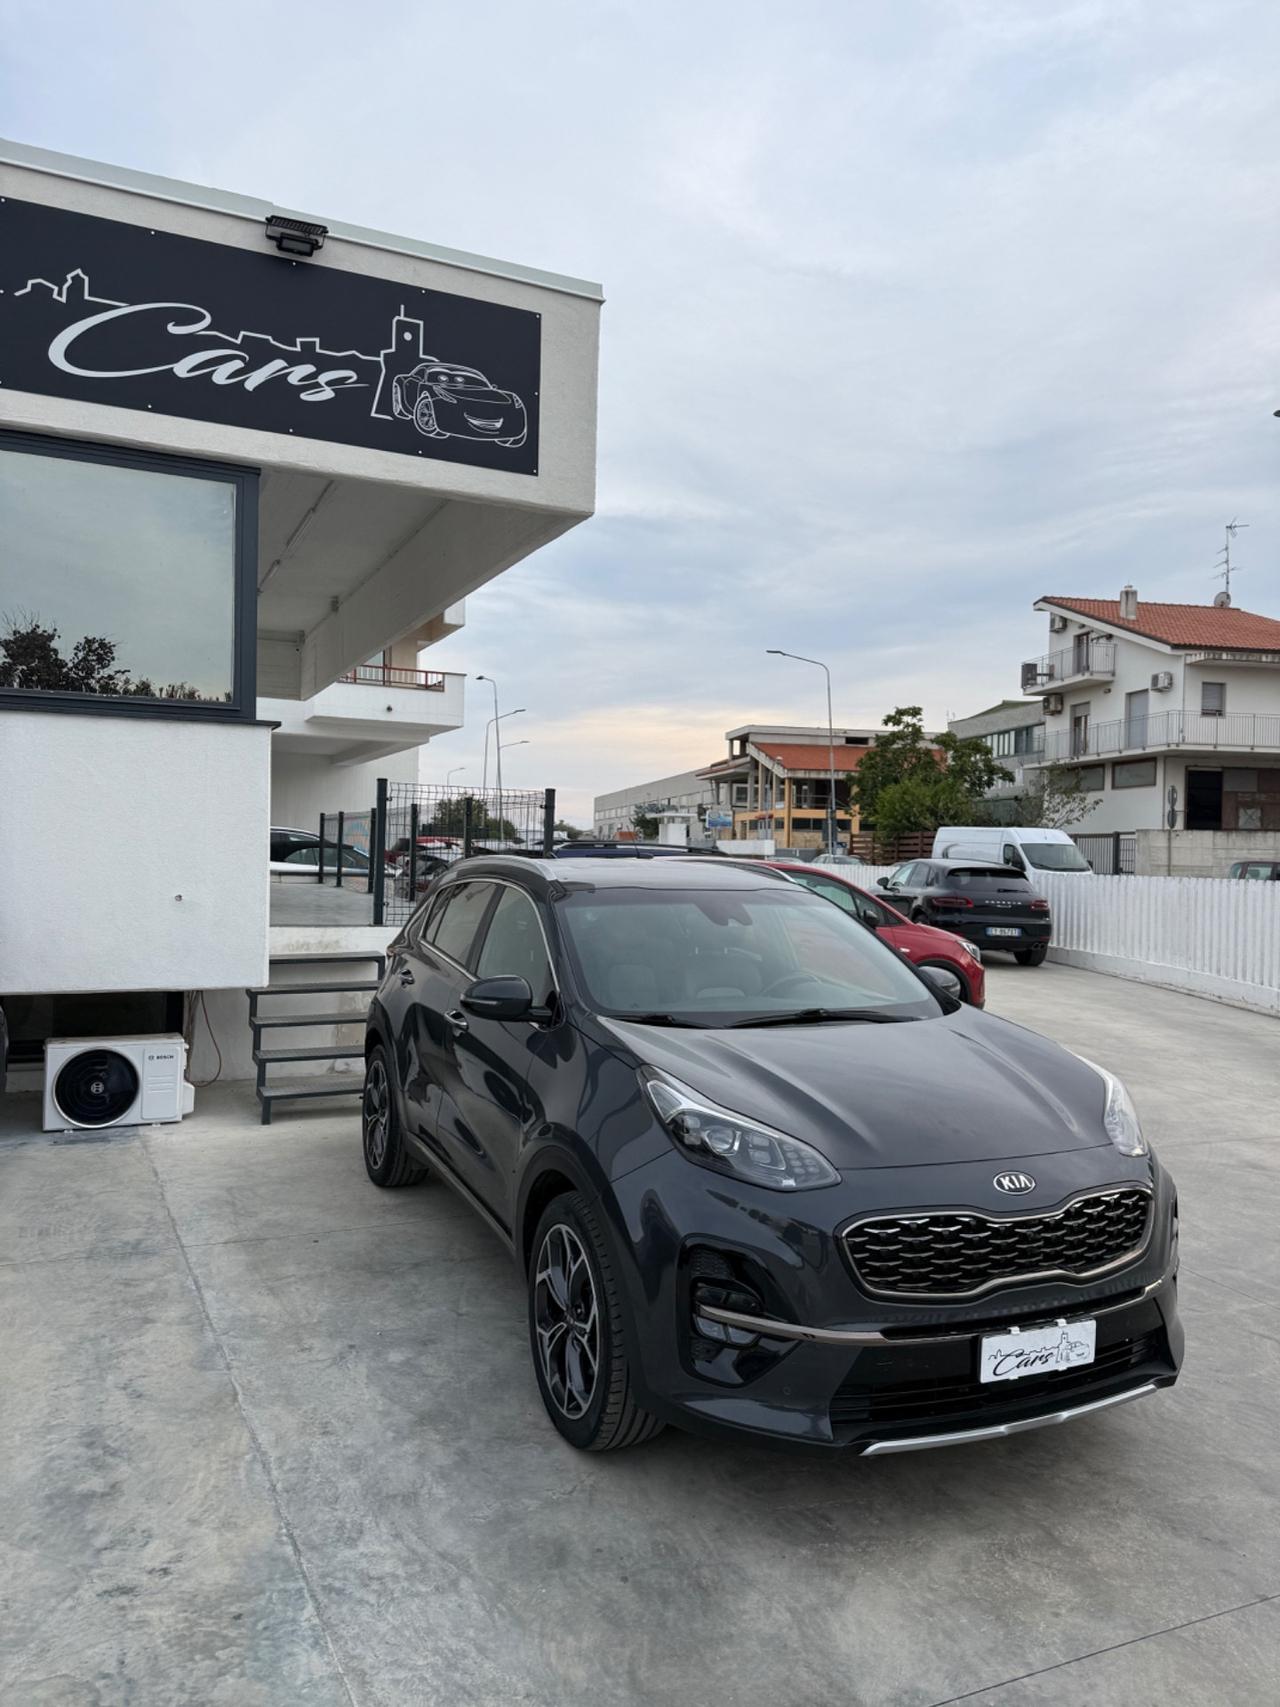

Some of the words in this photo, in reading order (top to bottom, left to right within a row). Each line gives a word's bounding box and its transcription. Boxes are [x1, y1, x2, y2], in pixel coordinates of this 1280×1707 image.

[48, 302, 370, 401] Cars
[999, 1175, 1031, 1190] KIA
[993, 1348, 1054, 1377] Cars
